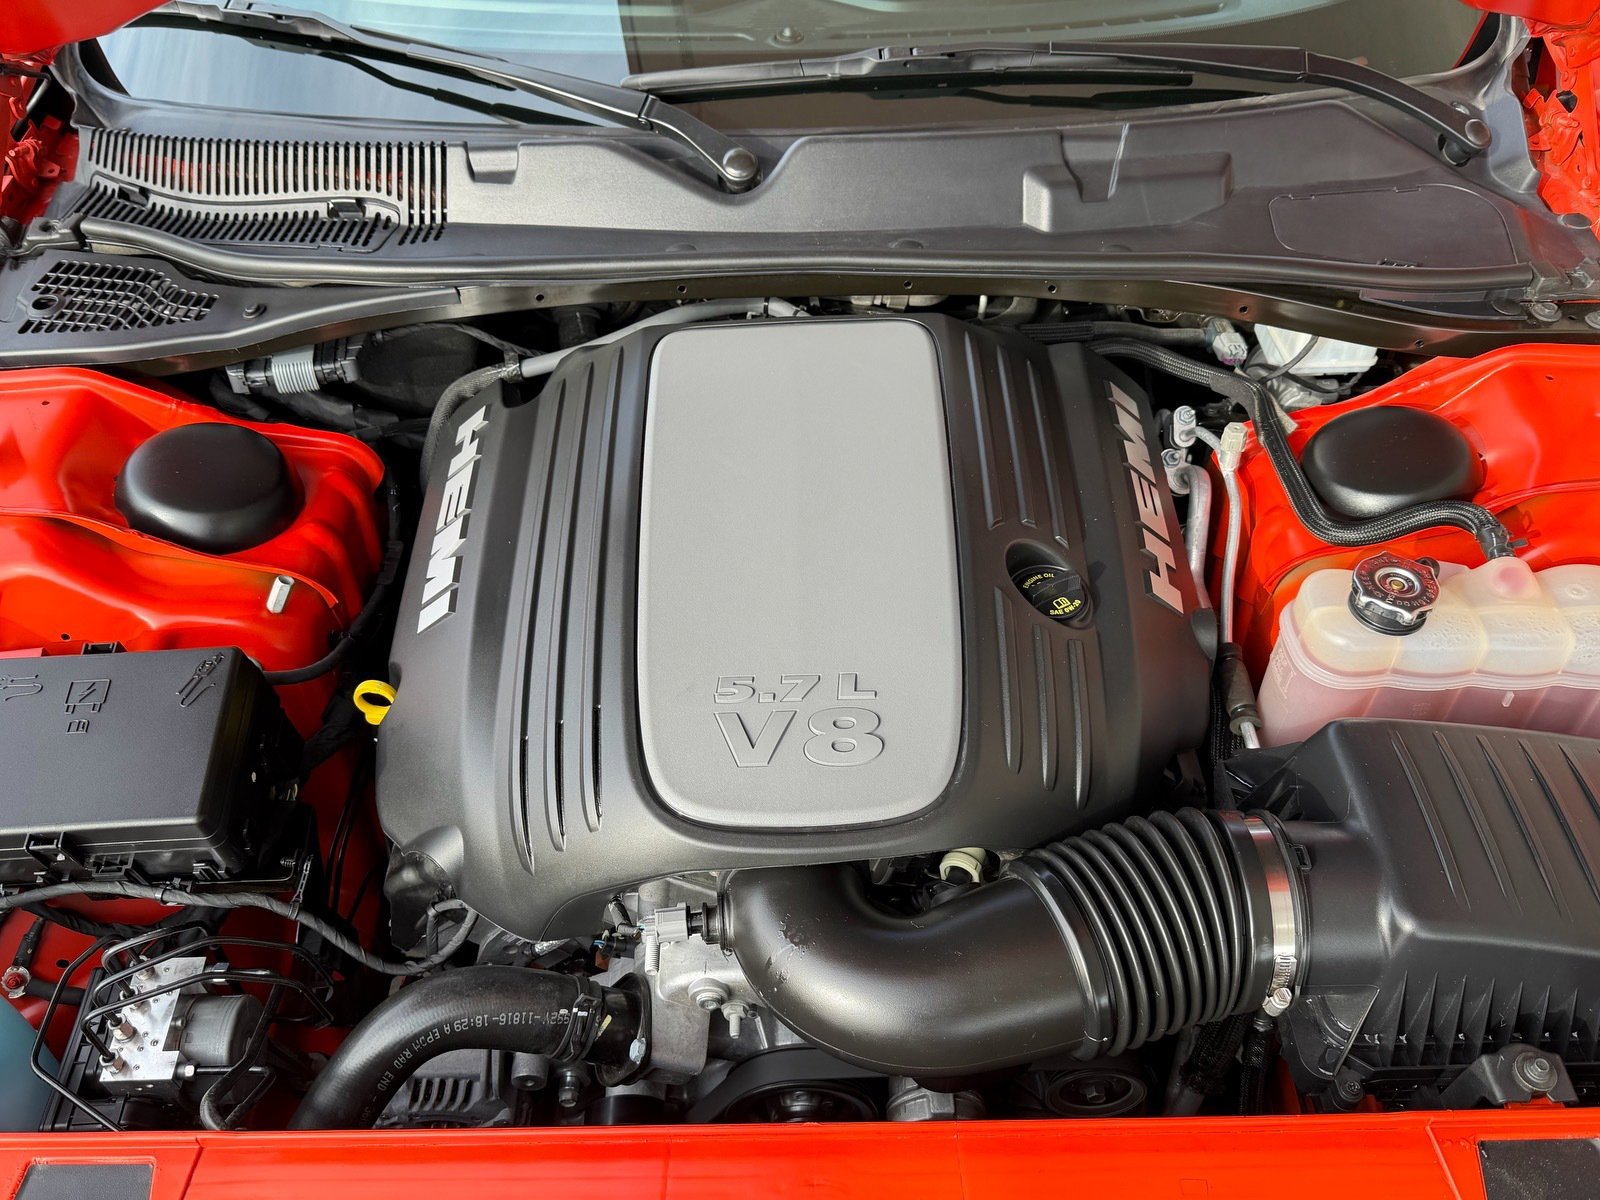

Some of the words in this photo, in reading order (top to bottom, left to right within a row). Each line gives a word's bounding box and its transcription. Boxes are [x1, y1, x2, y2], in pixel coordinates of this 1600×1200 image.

[1108, 381, 1184, 614] HEMI
[417, 405, 487, 634] HEMI
[1022, 574, 1043, 589] ENGINE
[713, 674, 822, 704] 5.7
[837, 672, 878, 700] L
[713, 706, 885, 768] V8
[393, 1048, 413, 1069] RAD
[377, 1071, 395, 1092] END
